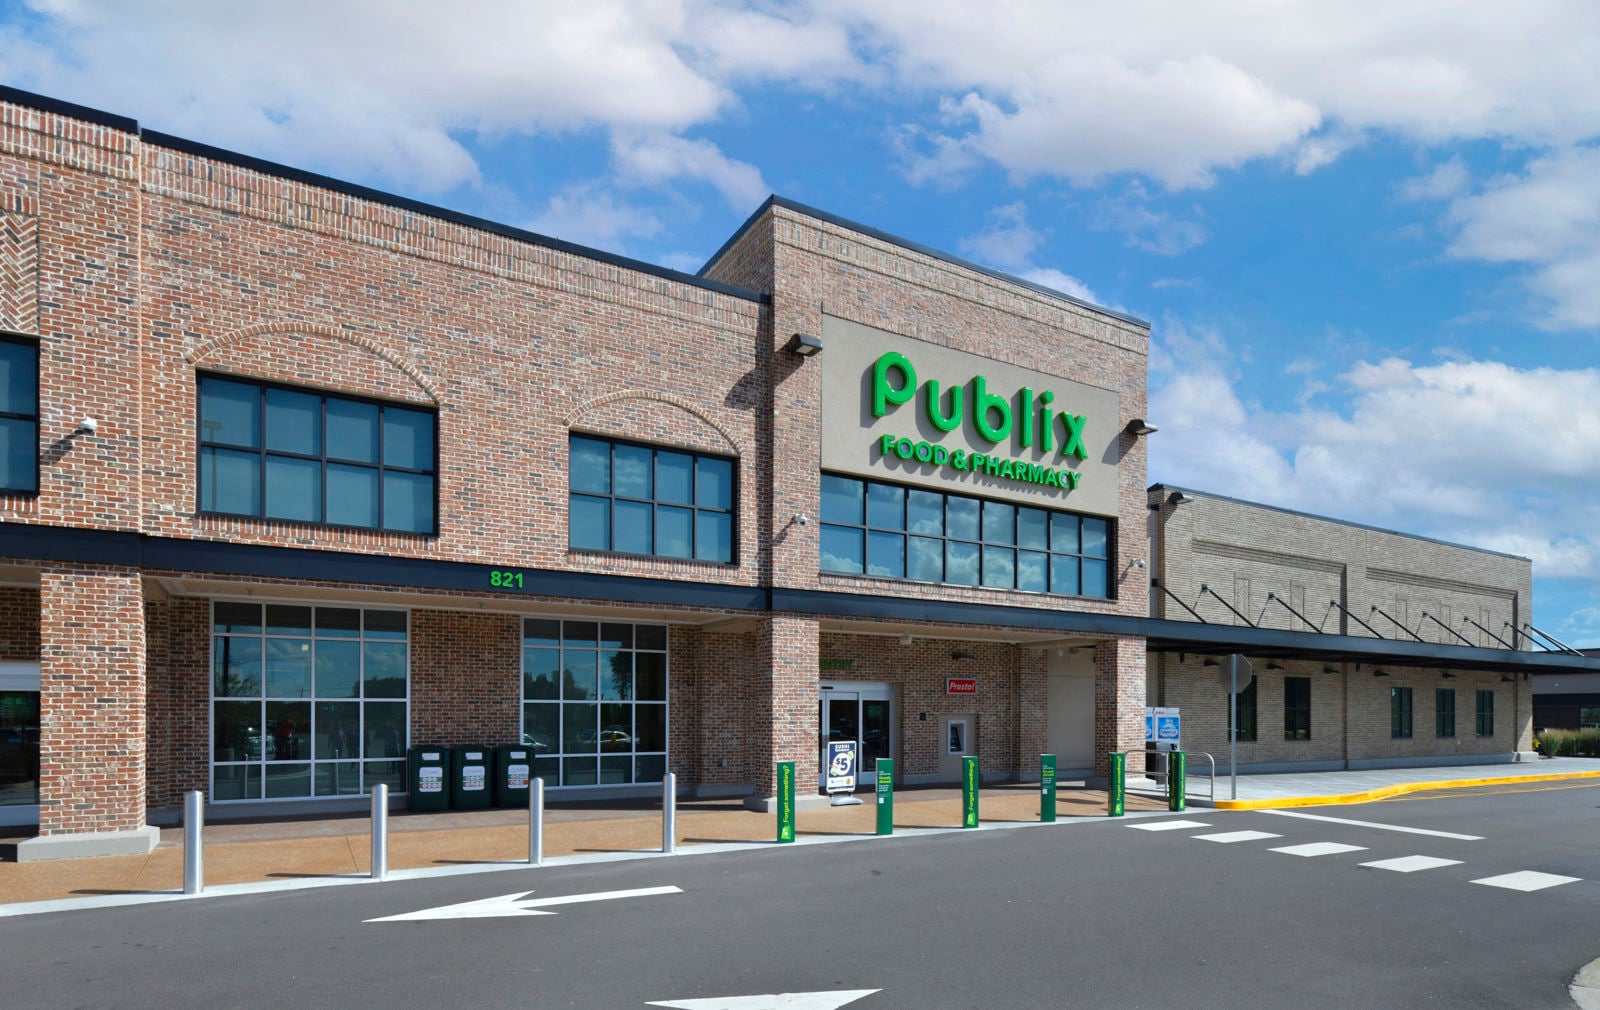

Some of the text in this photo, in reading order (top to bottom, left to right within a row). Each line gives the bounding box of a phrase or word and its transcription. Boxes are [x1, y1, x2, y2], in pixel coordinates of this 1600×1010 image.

[871, 351, 1088, 460] Publix
[880, 434, 1081, 490] FOOD & PHARMACY
[490, 570, 524, 588] 821
[949, 682, 975, 690] Presto!
[835, 757, 848, 771] $5
